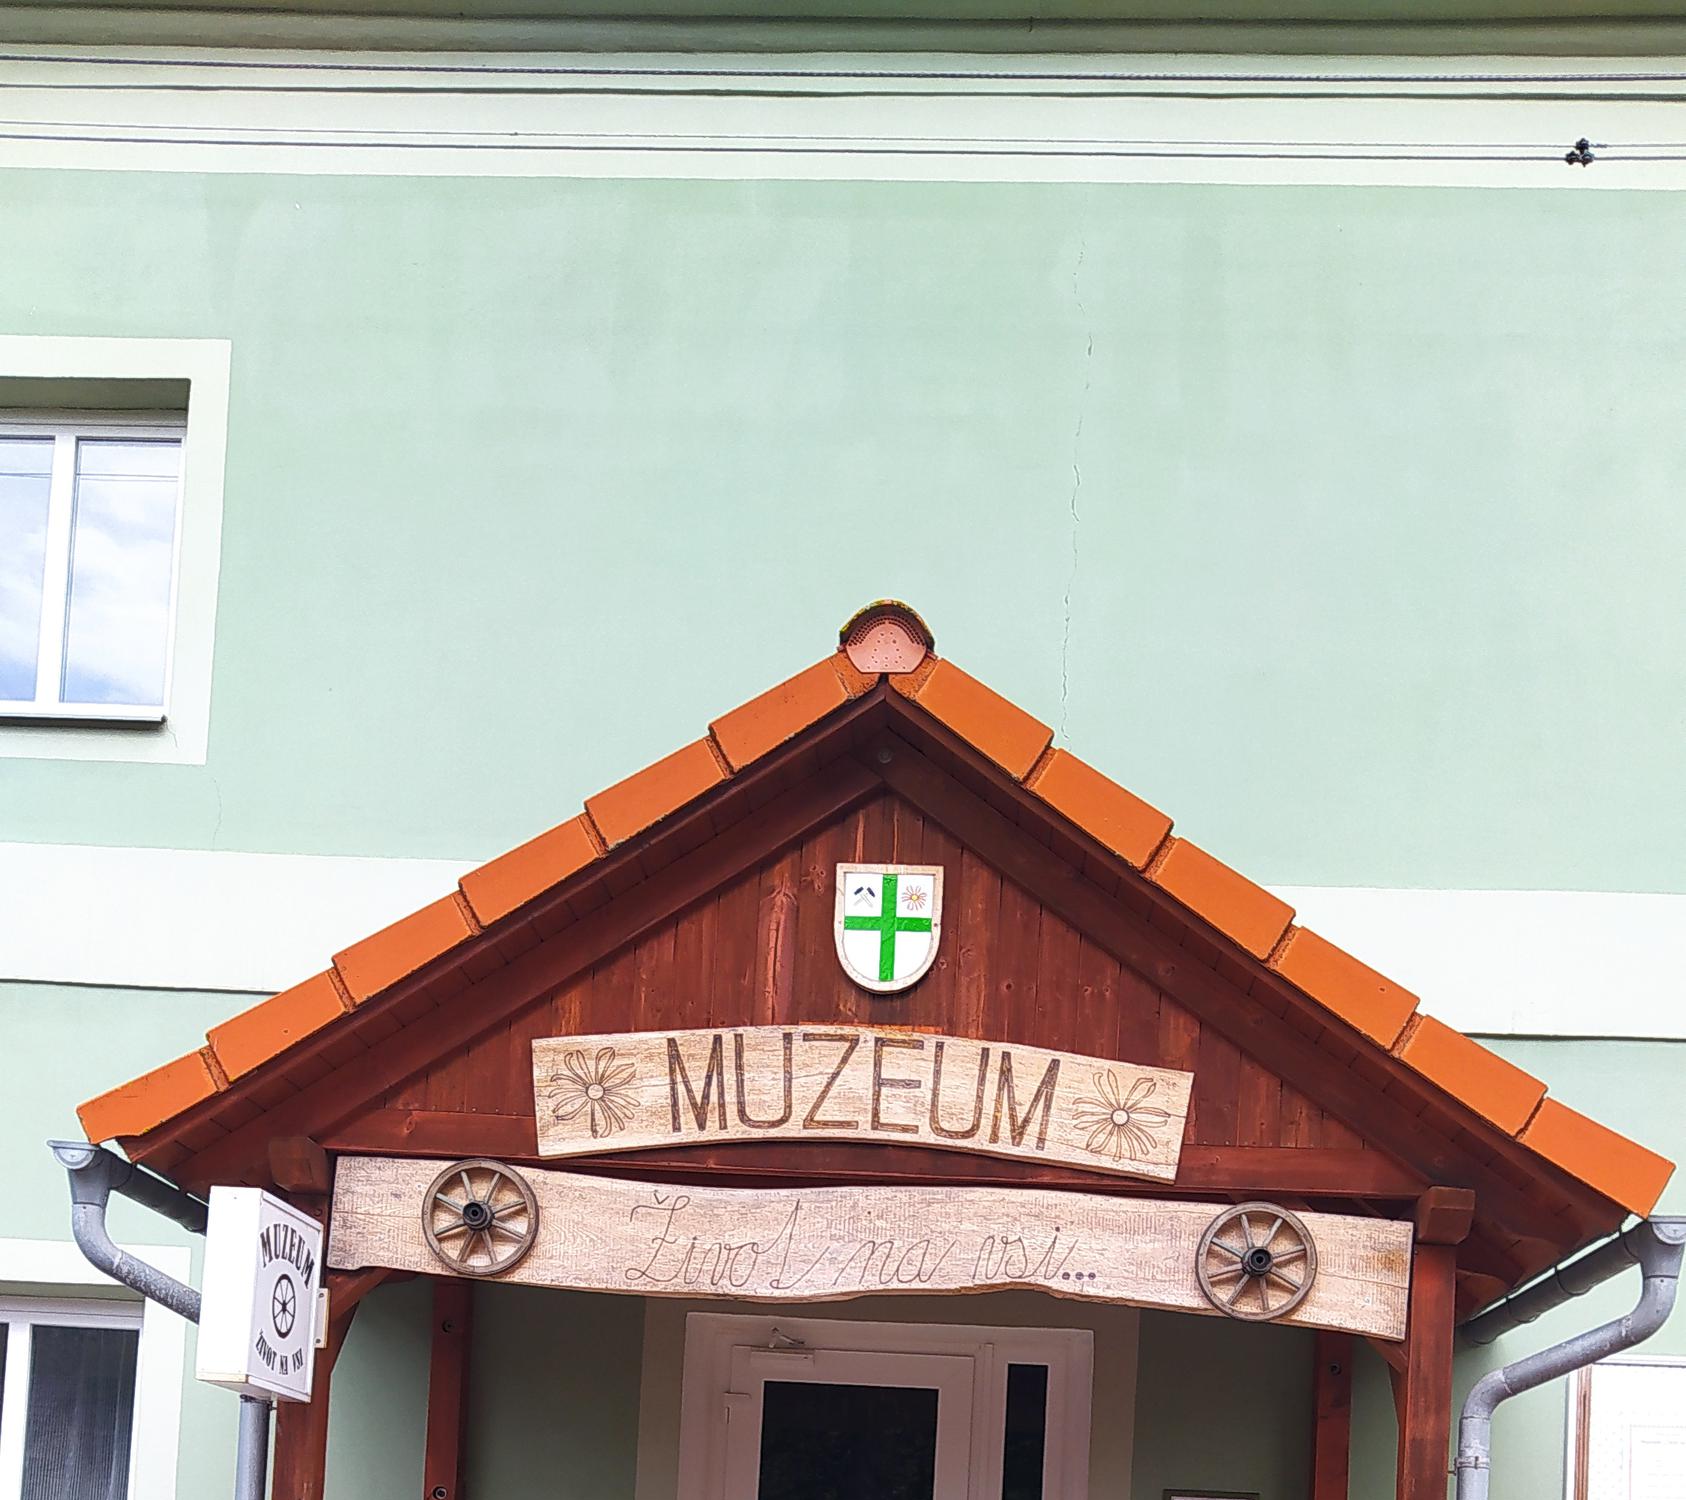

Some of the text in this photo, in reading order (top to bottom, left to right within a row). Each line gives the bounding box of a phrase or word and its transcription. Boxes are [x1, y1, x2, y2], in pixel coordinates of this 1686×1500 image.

[666, 1032, 1061, 1151] MUZEUM
[259, 1223, 315, 1289] MUZEUM
[624, 1189, 831, 1289] Život
[832, 1238, 957, 1285] na
[279, 1355, 289, 1375] NA
